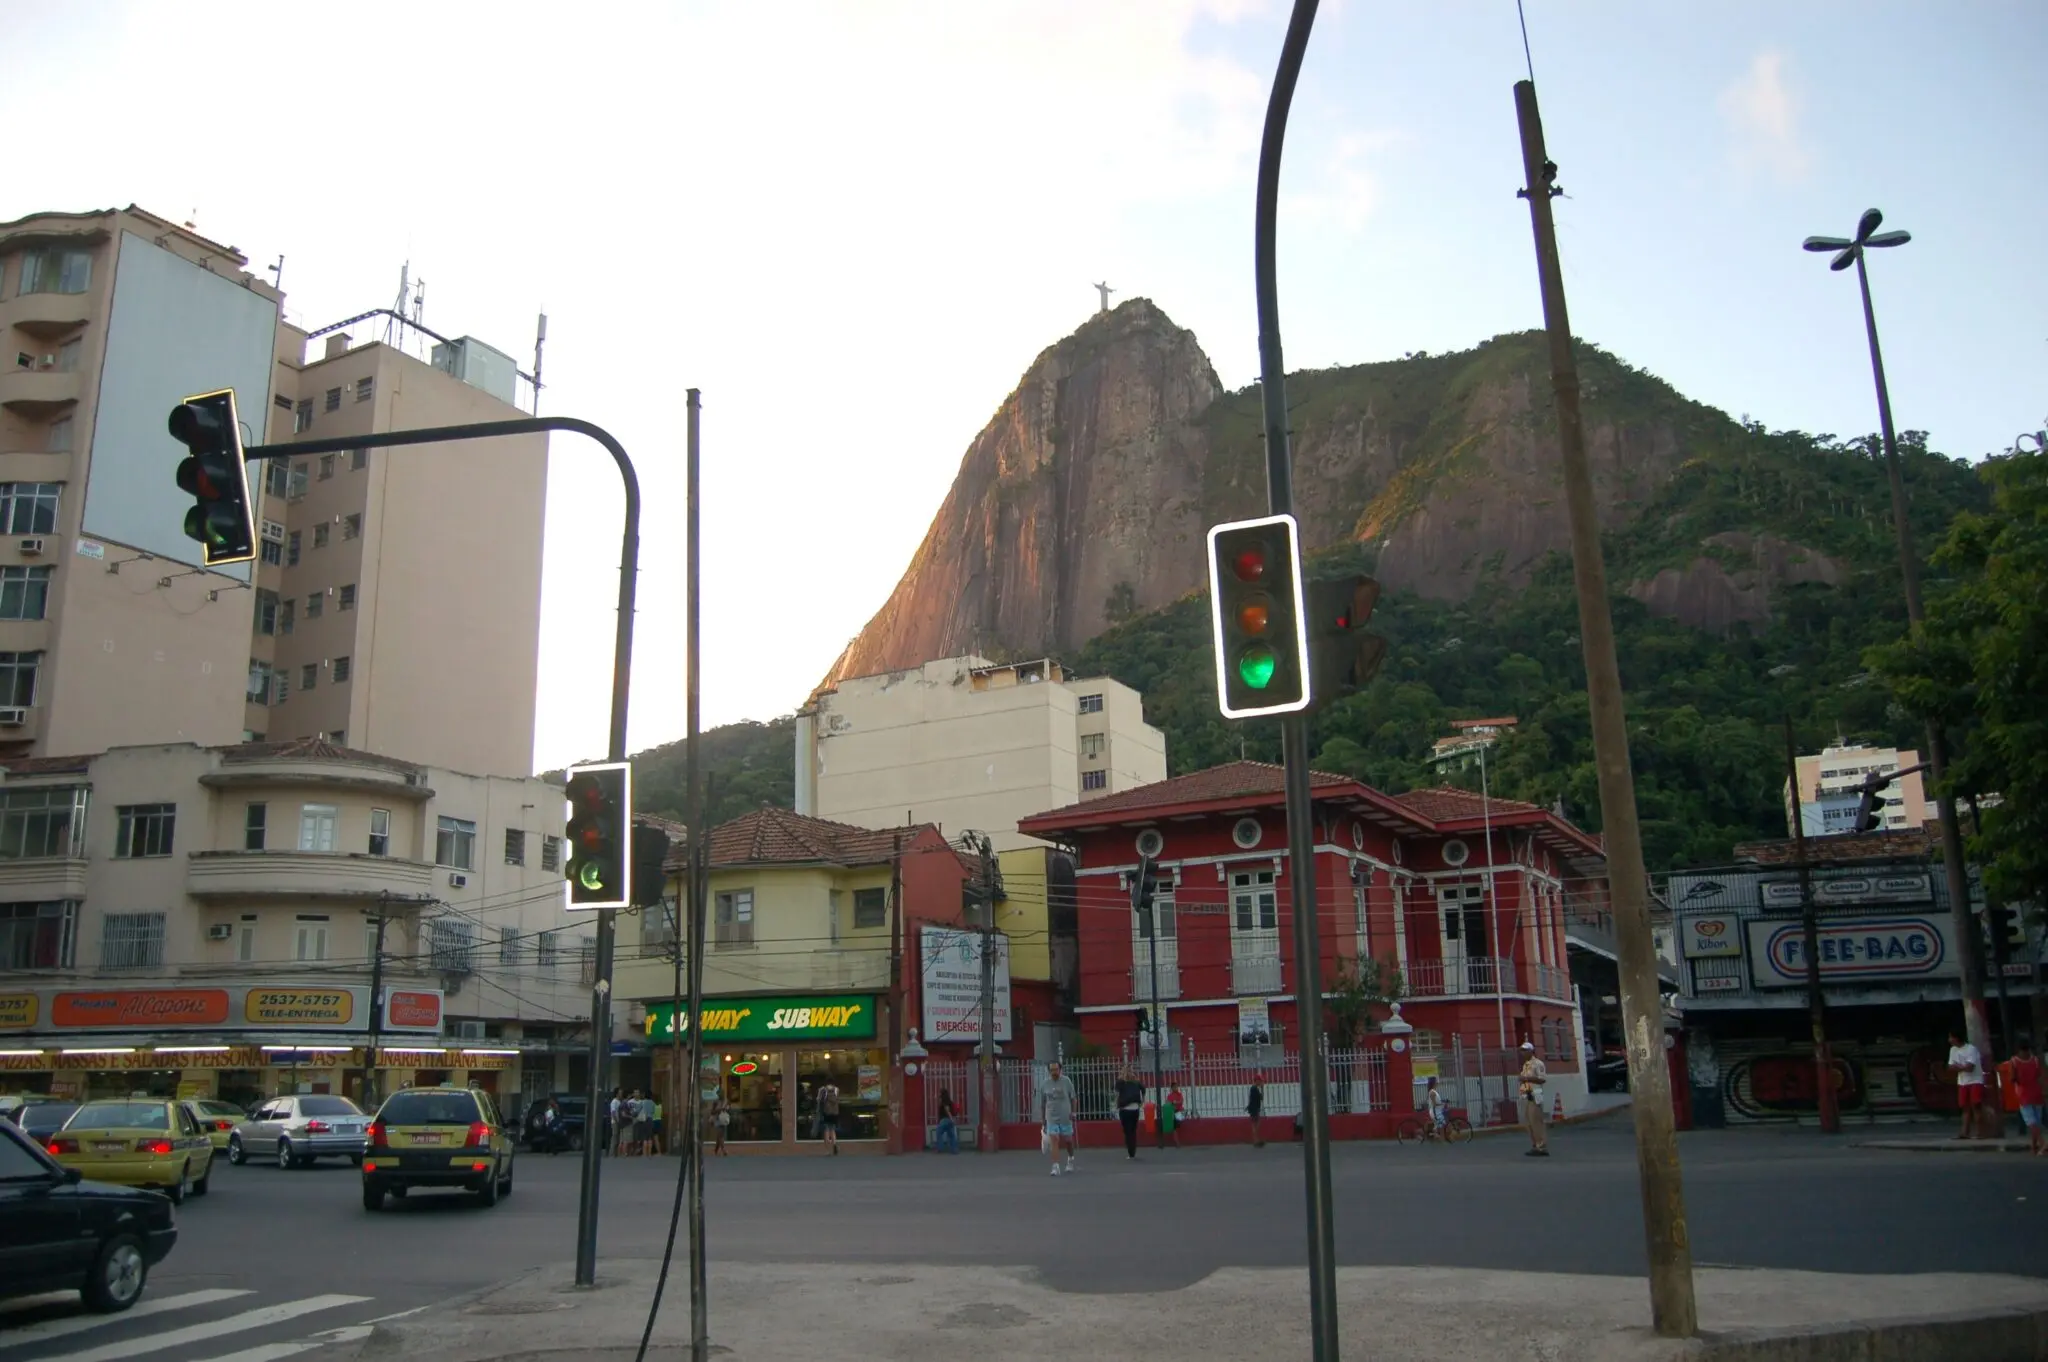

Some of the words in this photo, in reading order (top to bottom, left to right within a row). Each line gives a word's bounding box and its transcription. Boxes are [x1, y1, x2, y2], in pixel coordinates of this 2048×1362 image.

[1696, 937, 1728, 950] Kibon
[1783, 934, 1928, 964] FEE-BAG
[259, 994, 341, 1005] 2537-5757
[259, 1008, 340, 1019] TELE-ENTREGA
[665, 1008, 752, 1033] SUWAY
[766, 1004, 861, 1030] SUBWAY
[936, 1021, 983, 1032] EMERGENCI
[51, 1052, 106, 1069] MASSAS
[109, 1053, 118, 1068] E
[122, 1052, 189, 1068] SALADAS
[424, 1051, 478, 1067] ITALIANA
